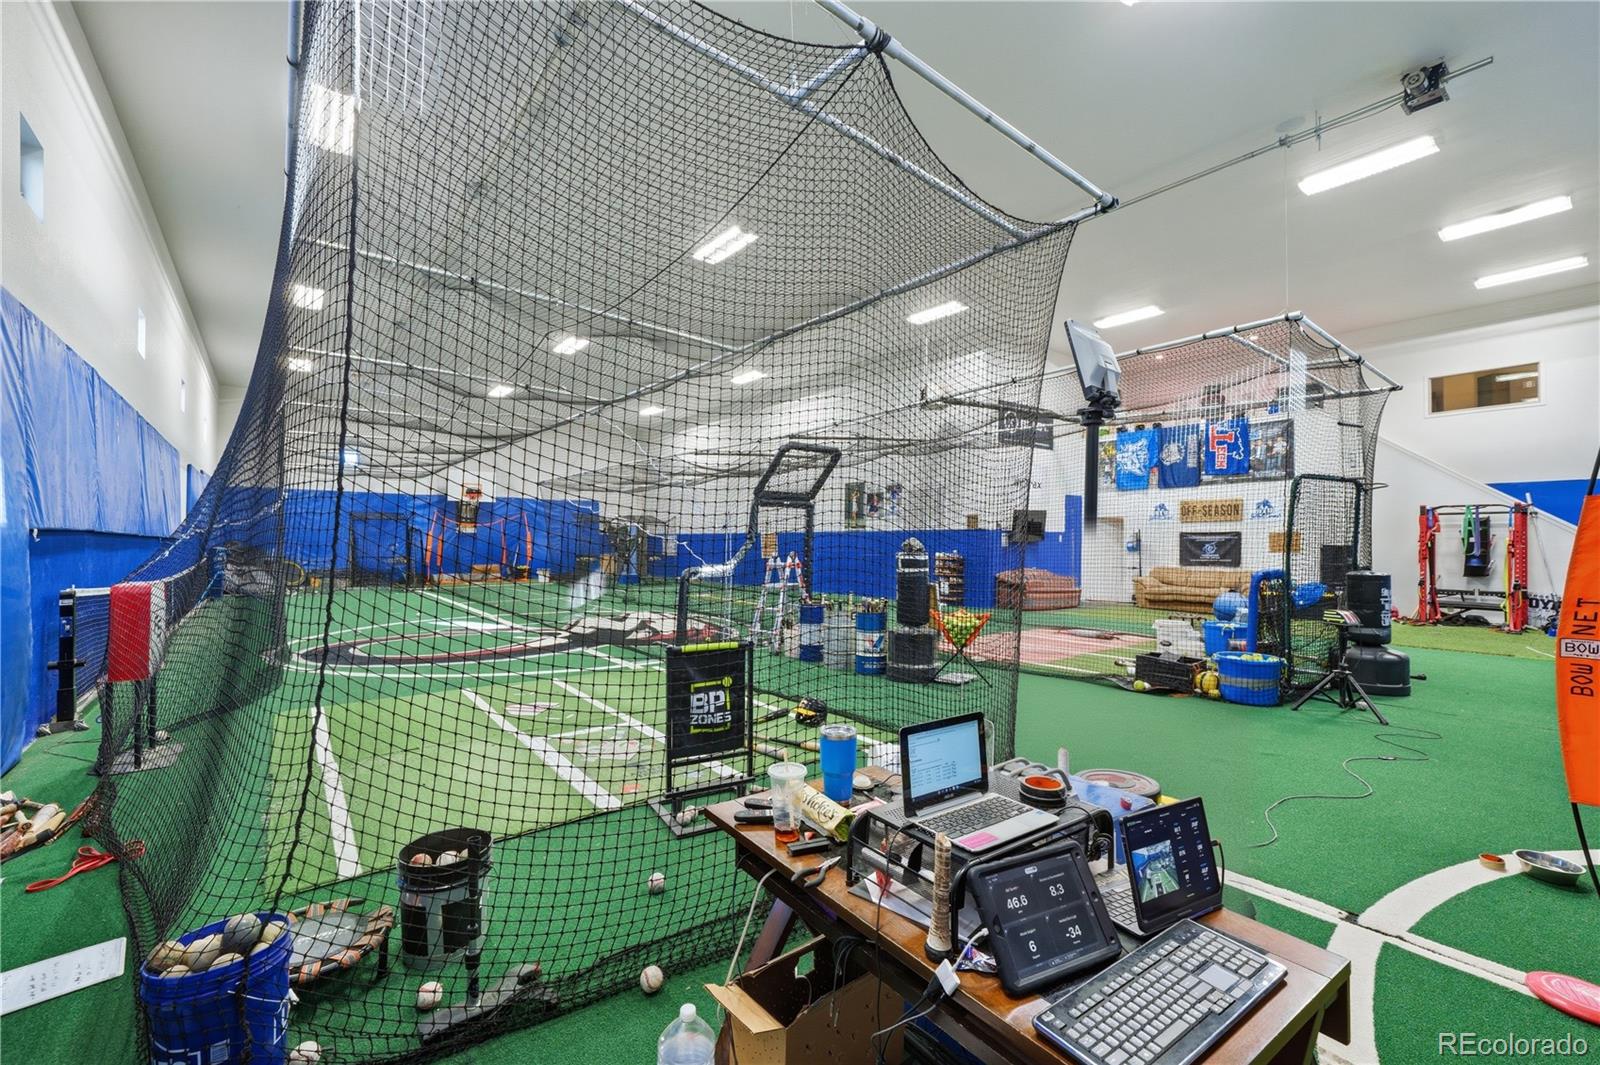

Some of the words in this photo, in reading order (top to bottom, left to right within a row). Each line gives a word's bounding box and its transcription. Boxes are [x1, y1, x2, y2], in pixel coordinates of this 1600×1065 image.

[1180, 503, 1240, 517] OFF-SEASON
[1571, 597, 1600, 636] NET
[1570, 662, 1594, 697] BOW
[690, 690, 726, 714] BP
[689, 711, 732, 725] ZONES
[1049, 883, 1065, 897] 8.3
[1006, 894, 1028, 910] 46.6
[1065, 924, 1082, 939] -34
[1028, 940, 1037, 952] 6
